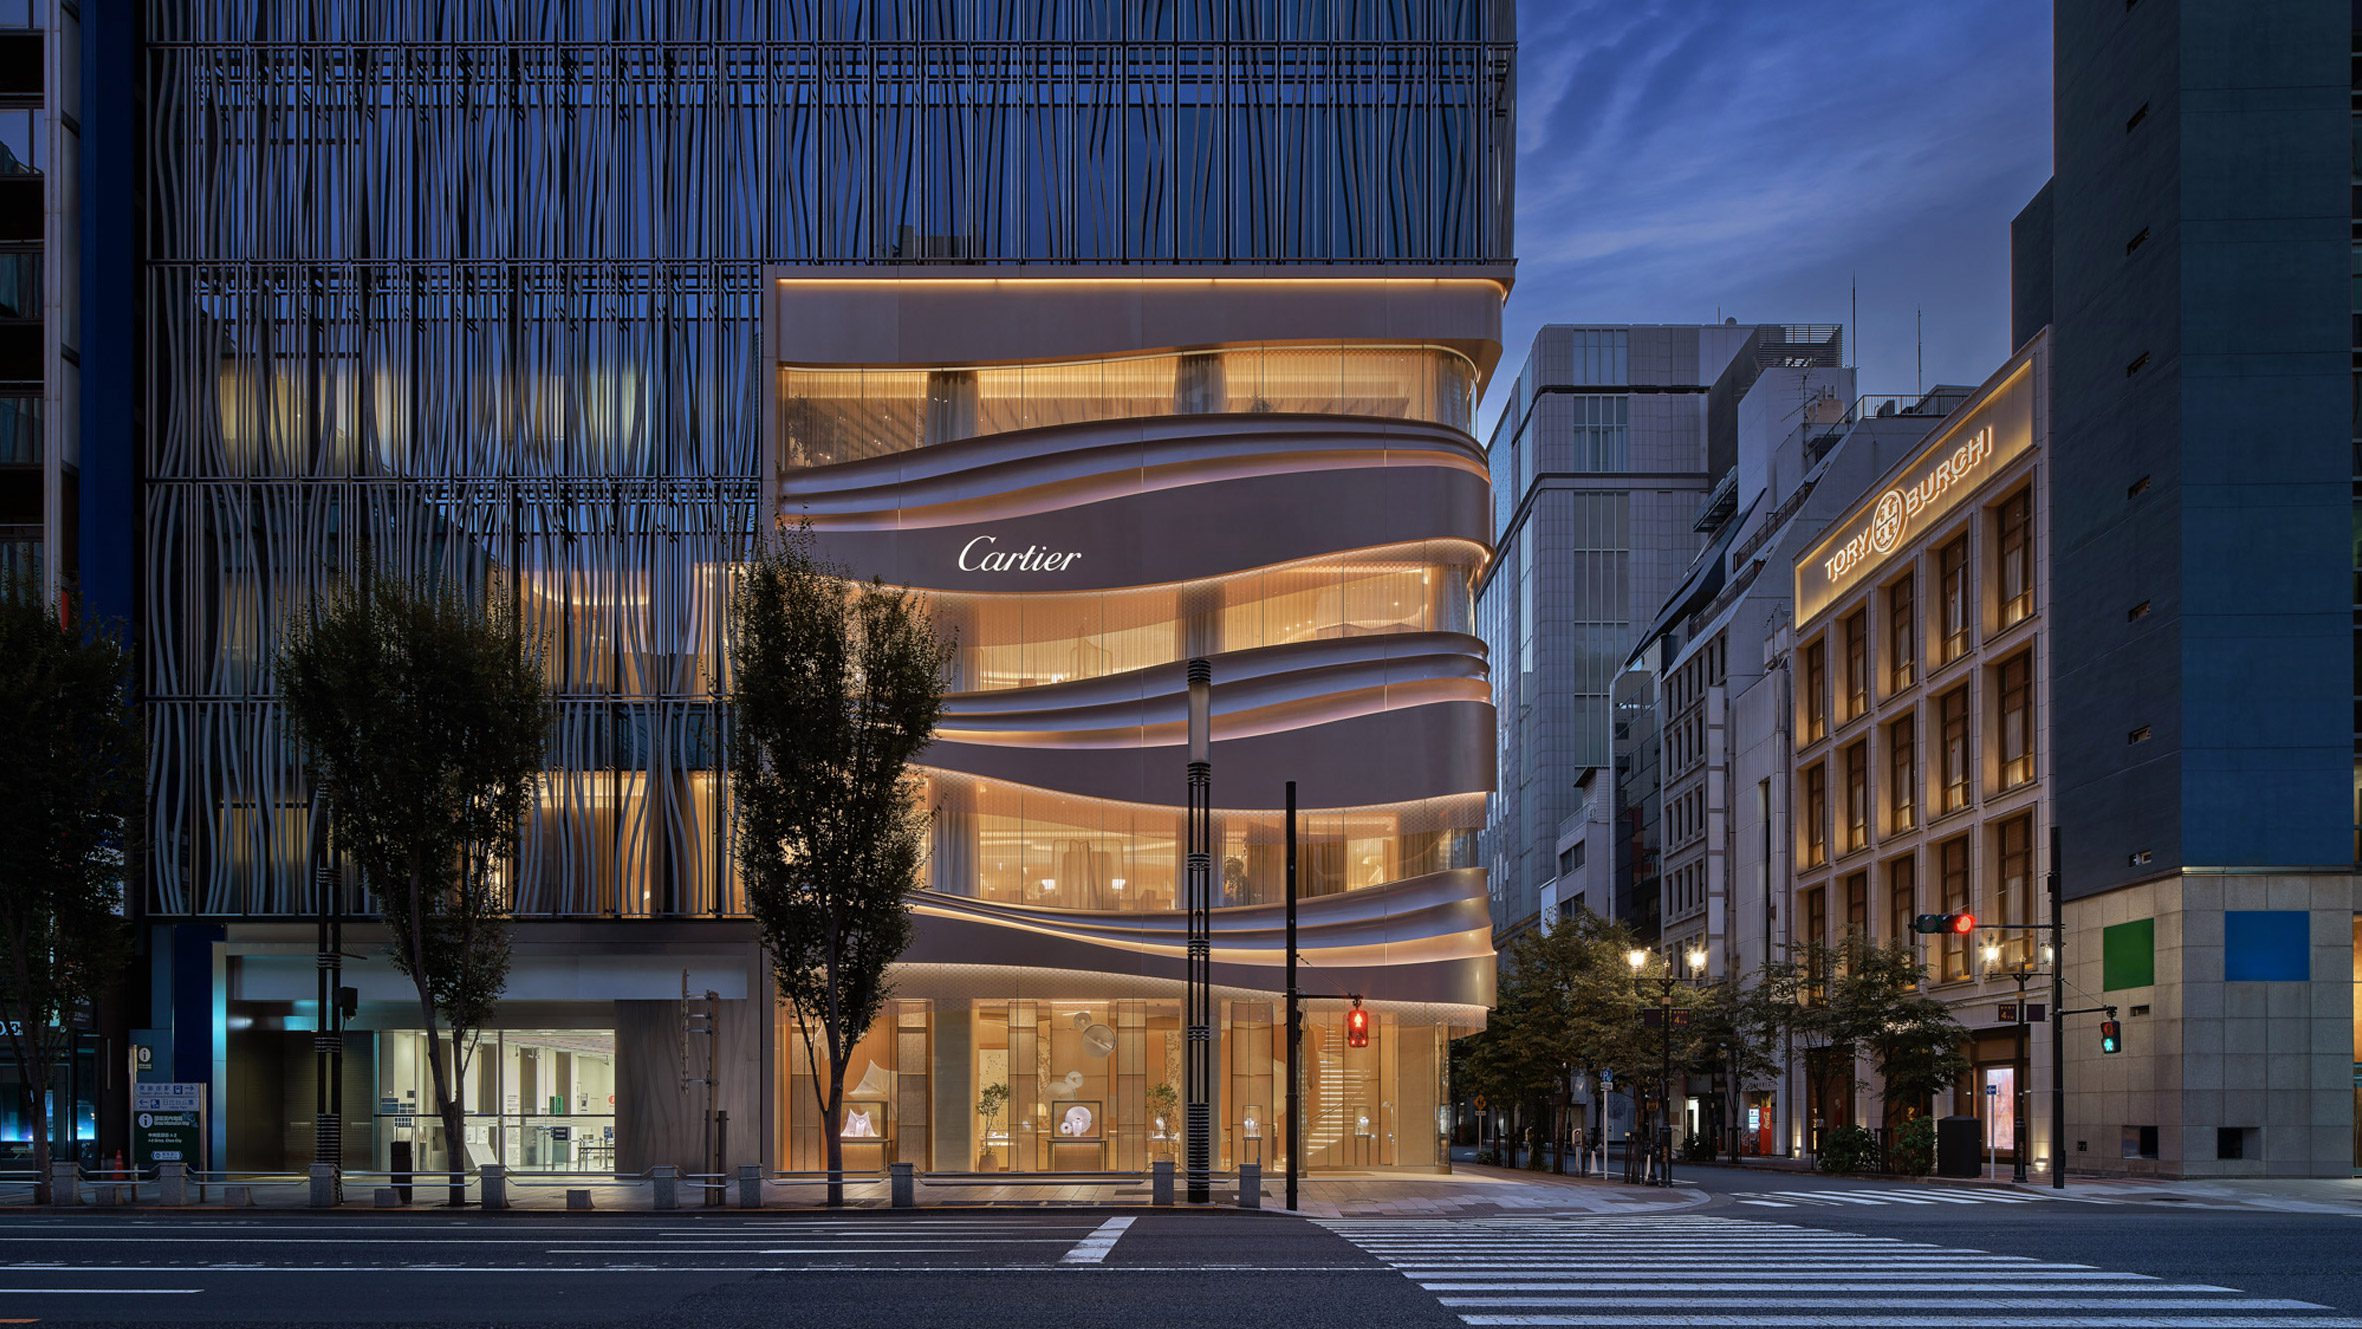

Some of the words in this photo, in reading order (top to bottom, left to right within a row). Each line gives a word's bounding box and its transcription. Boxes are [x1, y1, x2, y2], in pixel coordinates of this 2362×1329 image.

[1825, 527, 1871, 581] TORY
[1906, 427, 1991, 517] BURCH
[958, 535, 1082, 571] Cartier
